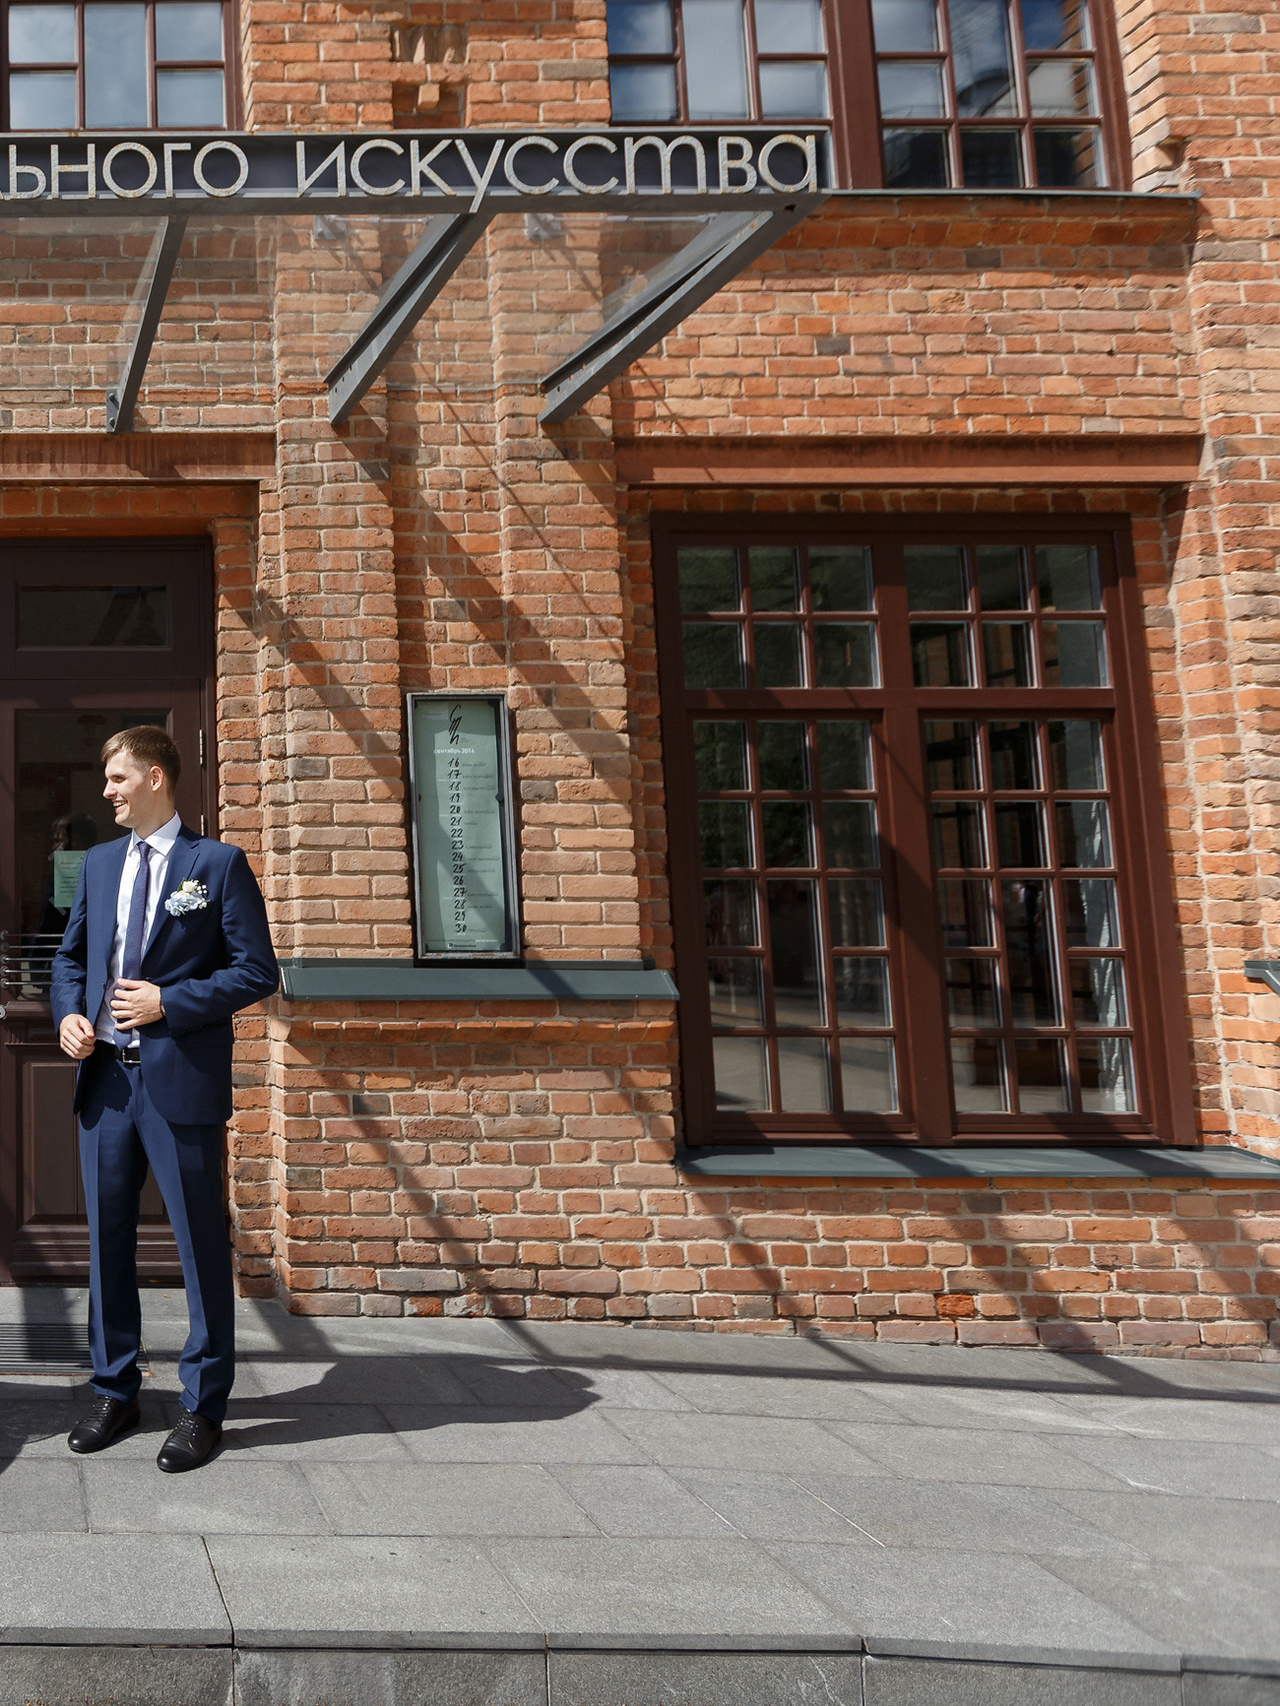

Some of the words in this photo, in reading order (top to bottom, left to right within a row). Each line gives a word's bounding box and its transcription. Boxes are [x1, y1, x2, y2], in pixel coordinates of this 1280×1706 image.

[295, 133, 817, 214] искусства
[448, 758, 460, 767] 16
[447, 769, 462, 779] 17
[449, 793, 460, 803] 19
[450, 805, 461, 814] 20
[450, 817, 462, 826] 21
[451, 829, 463, 838] 22
[451, 840, 464, 850] 23
[452, 852, 463, 862] 24
[452, 863, 466, 873] 25
[453, 875, 464, 886] 26
[454, 887, 467, 897] 27
[454, 911, 466, 921] 29
[455, 923, 467, 933] 30
